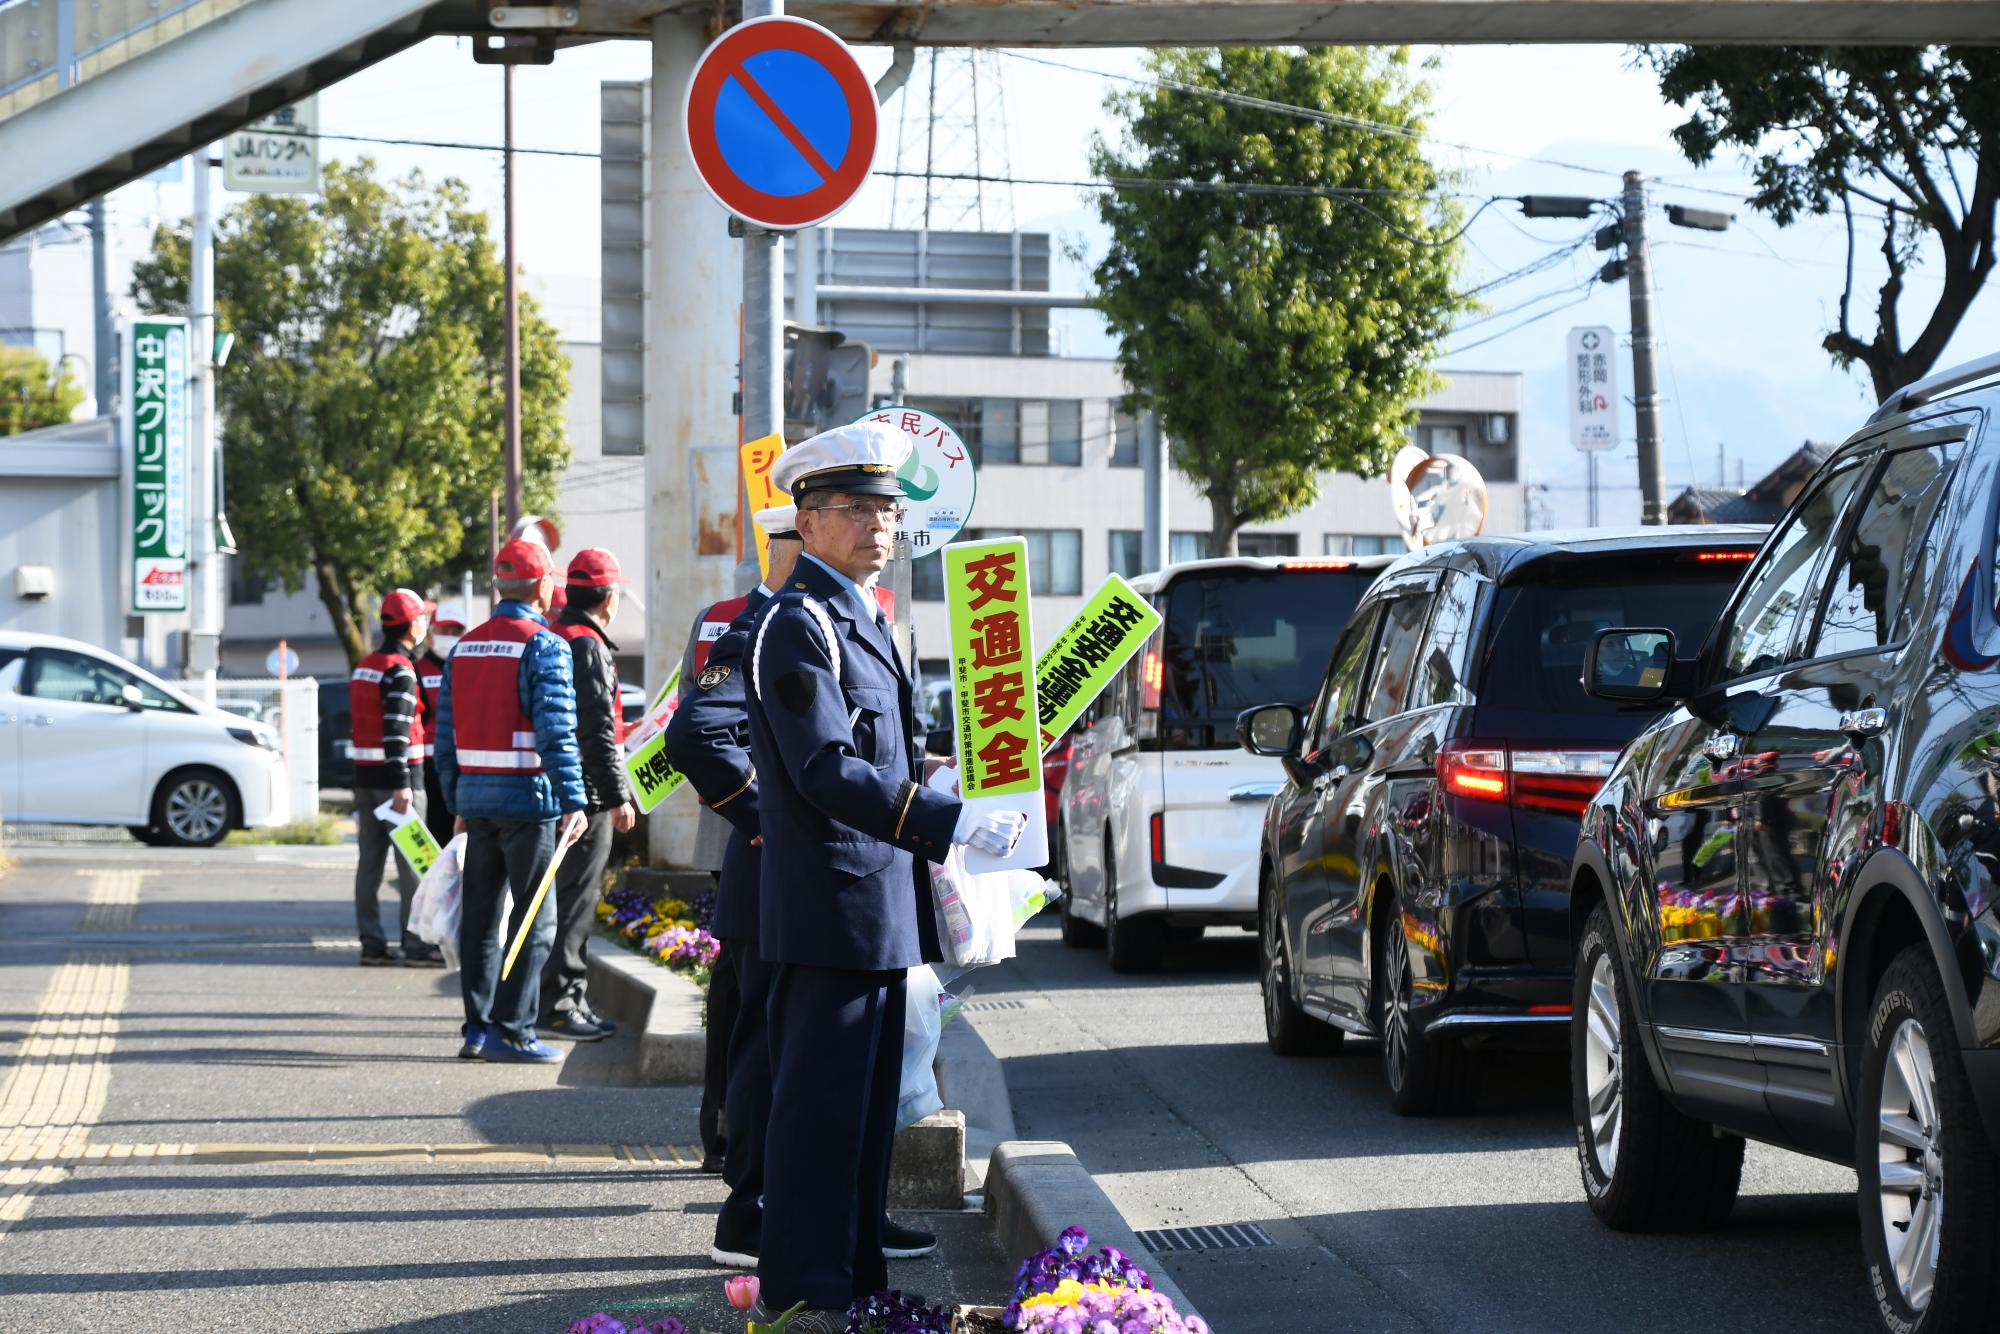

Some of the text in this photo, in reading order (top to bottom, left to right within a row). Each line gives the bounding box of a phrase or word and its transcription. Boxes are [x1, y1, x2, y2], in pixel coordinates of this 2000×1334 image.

[135, 333, 165, 548] 中沢クリニック
[964, 551, 1031, 790] 交通安全
